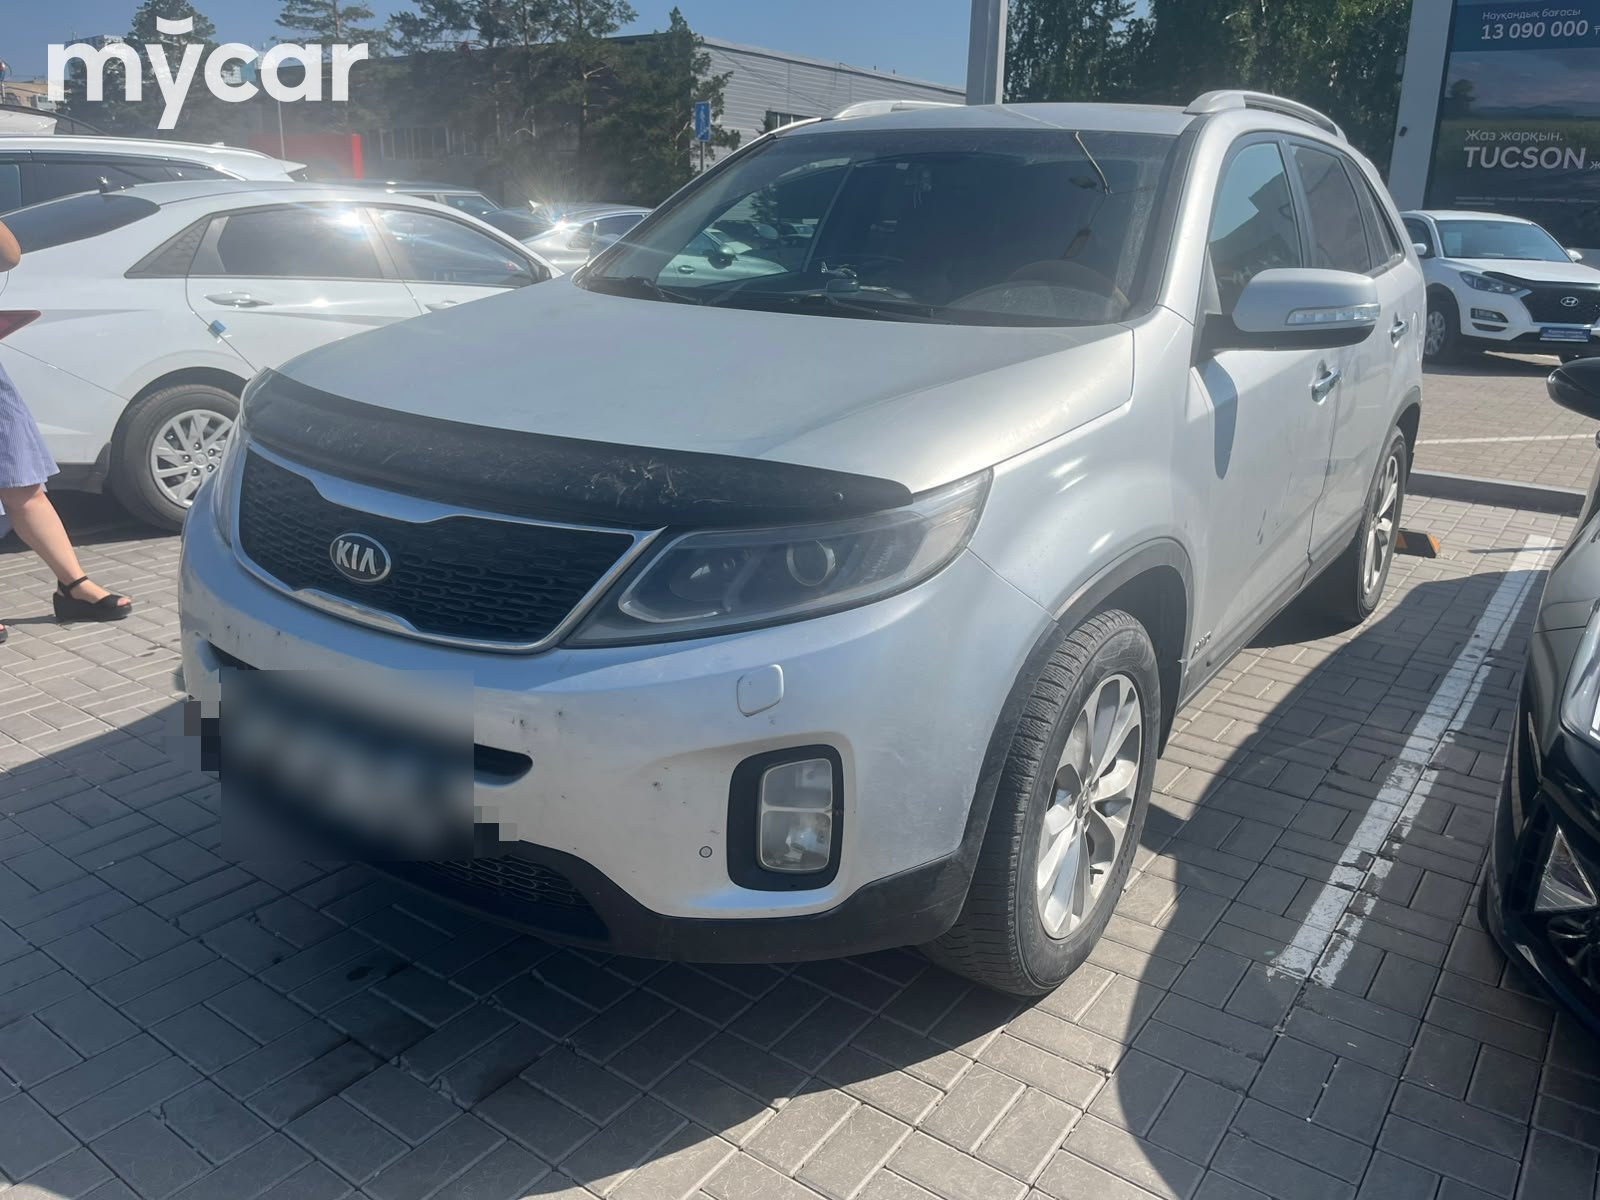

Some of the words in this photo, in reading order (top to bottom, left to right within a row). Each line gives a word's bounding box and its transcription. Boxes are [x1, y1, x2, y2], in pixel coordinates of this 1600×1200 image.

[1481, 24, 1504, 40] 13
[1509, 22, 1545, 39] 090
[1551, 20, 1589, 37] 000
[1465, 129, 1497, 142] Жаз
[1463, 146, 1587, 170] TUCSON
[336, 540, 377, 575] KIA
